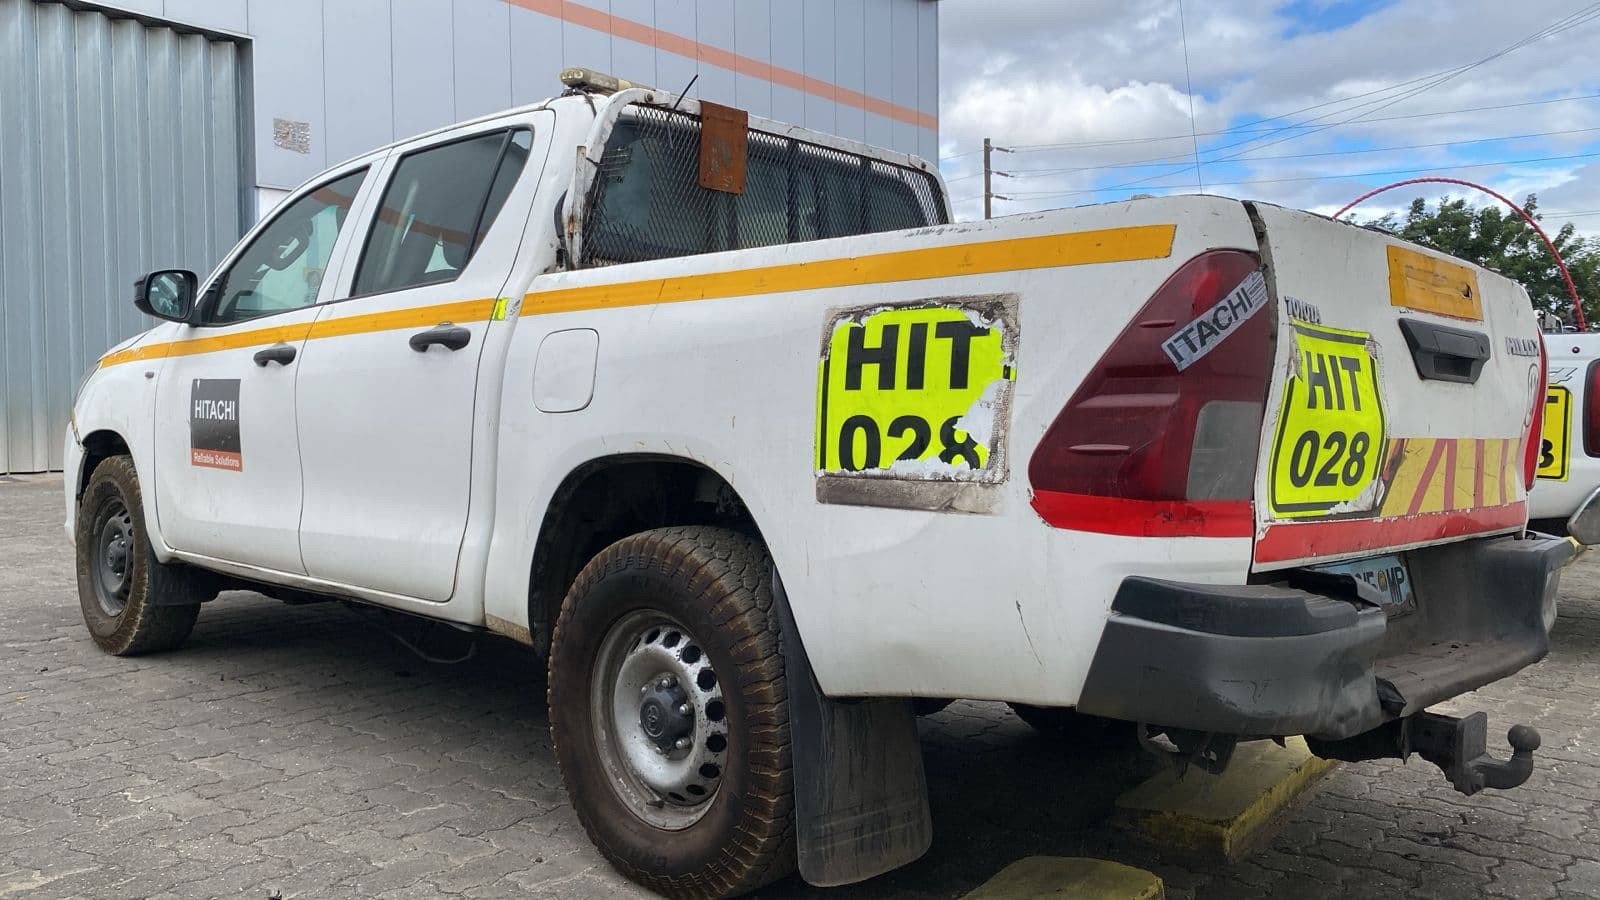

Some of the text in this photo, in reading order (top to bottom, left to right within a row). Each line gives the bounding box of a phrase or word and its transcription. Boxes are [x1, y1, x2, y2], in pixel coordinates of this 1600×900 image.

[844, 319, 991, 391] HIT
[1166, 287, 1254, 363] ITACHI
[194, 399, 236, 421] HITACHI
[1305, 350, 1362, 412] HIT
[193, 451, 240, 467] Reliable Solutions
[838, 414, 981, 472] 028
[1289, 429, 1371, 489] 028
